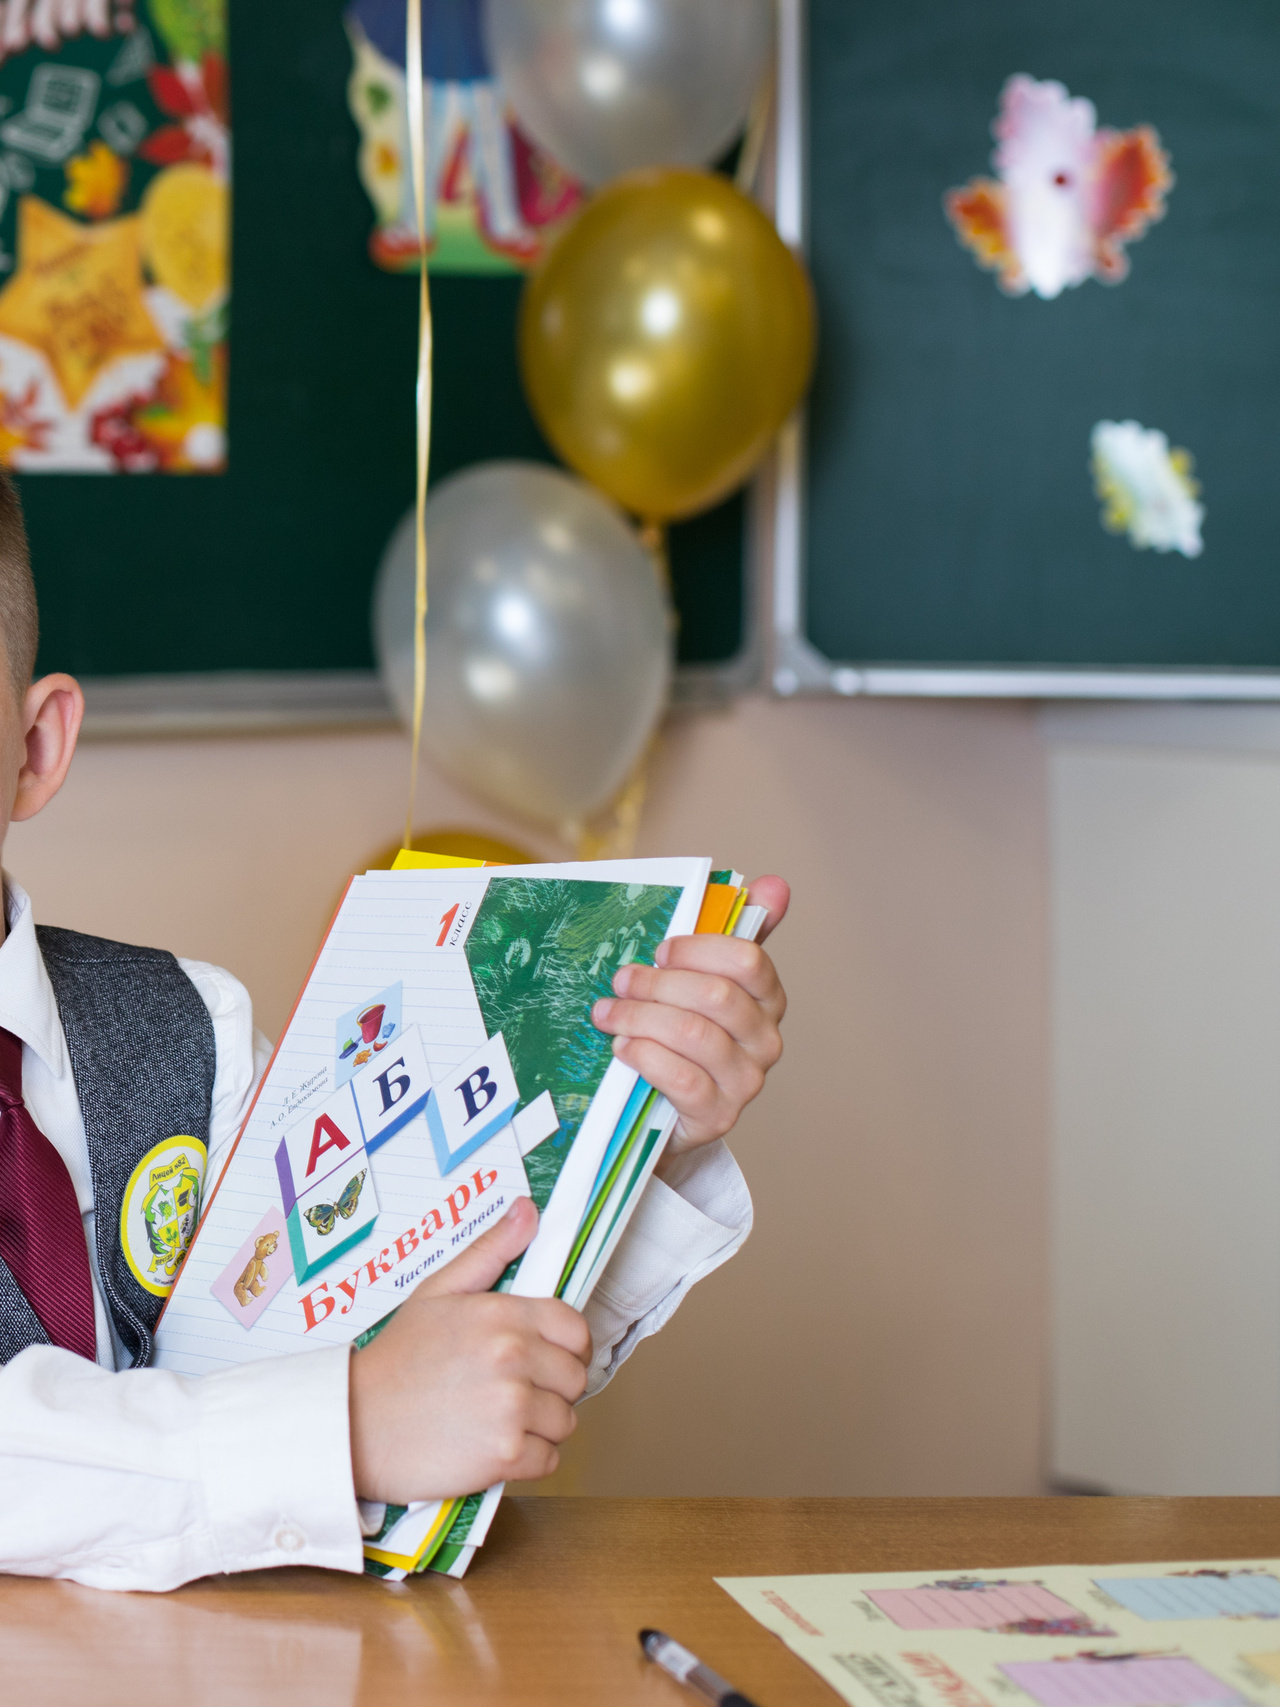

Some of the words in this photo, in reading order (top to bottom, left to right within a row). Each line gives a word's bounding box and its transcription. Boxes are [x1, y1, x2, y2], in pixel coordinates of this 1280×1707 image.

[435, 903, 460, 947] 1
[449, 901, 472, 947] класс
[305, 1113, 351, 1179] А
[372, 1056, 411, 1117] Б
[454, 1066, 498, 1127] В
[152, 1164, 174, 1182] Лицей
[298, 1167, 498, 1334] Букварь
[394, 1249, 444, 1289] Часть
[451, 1196, 504, 1246] первая
